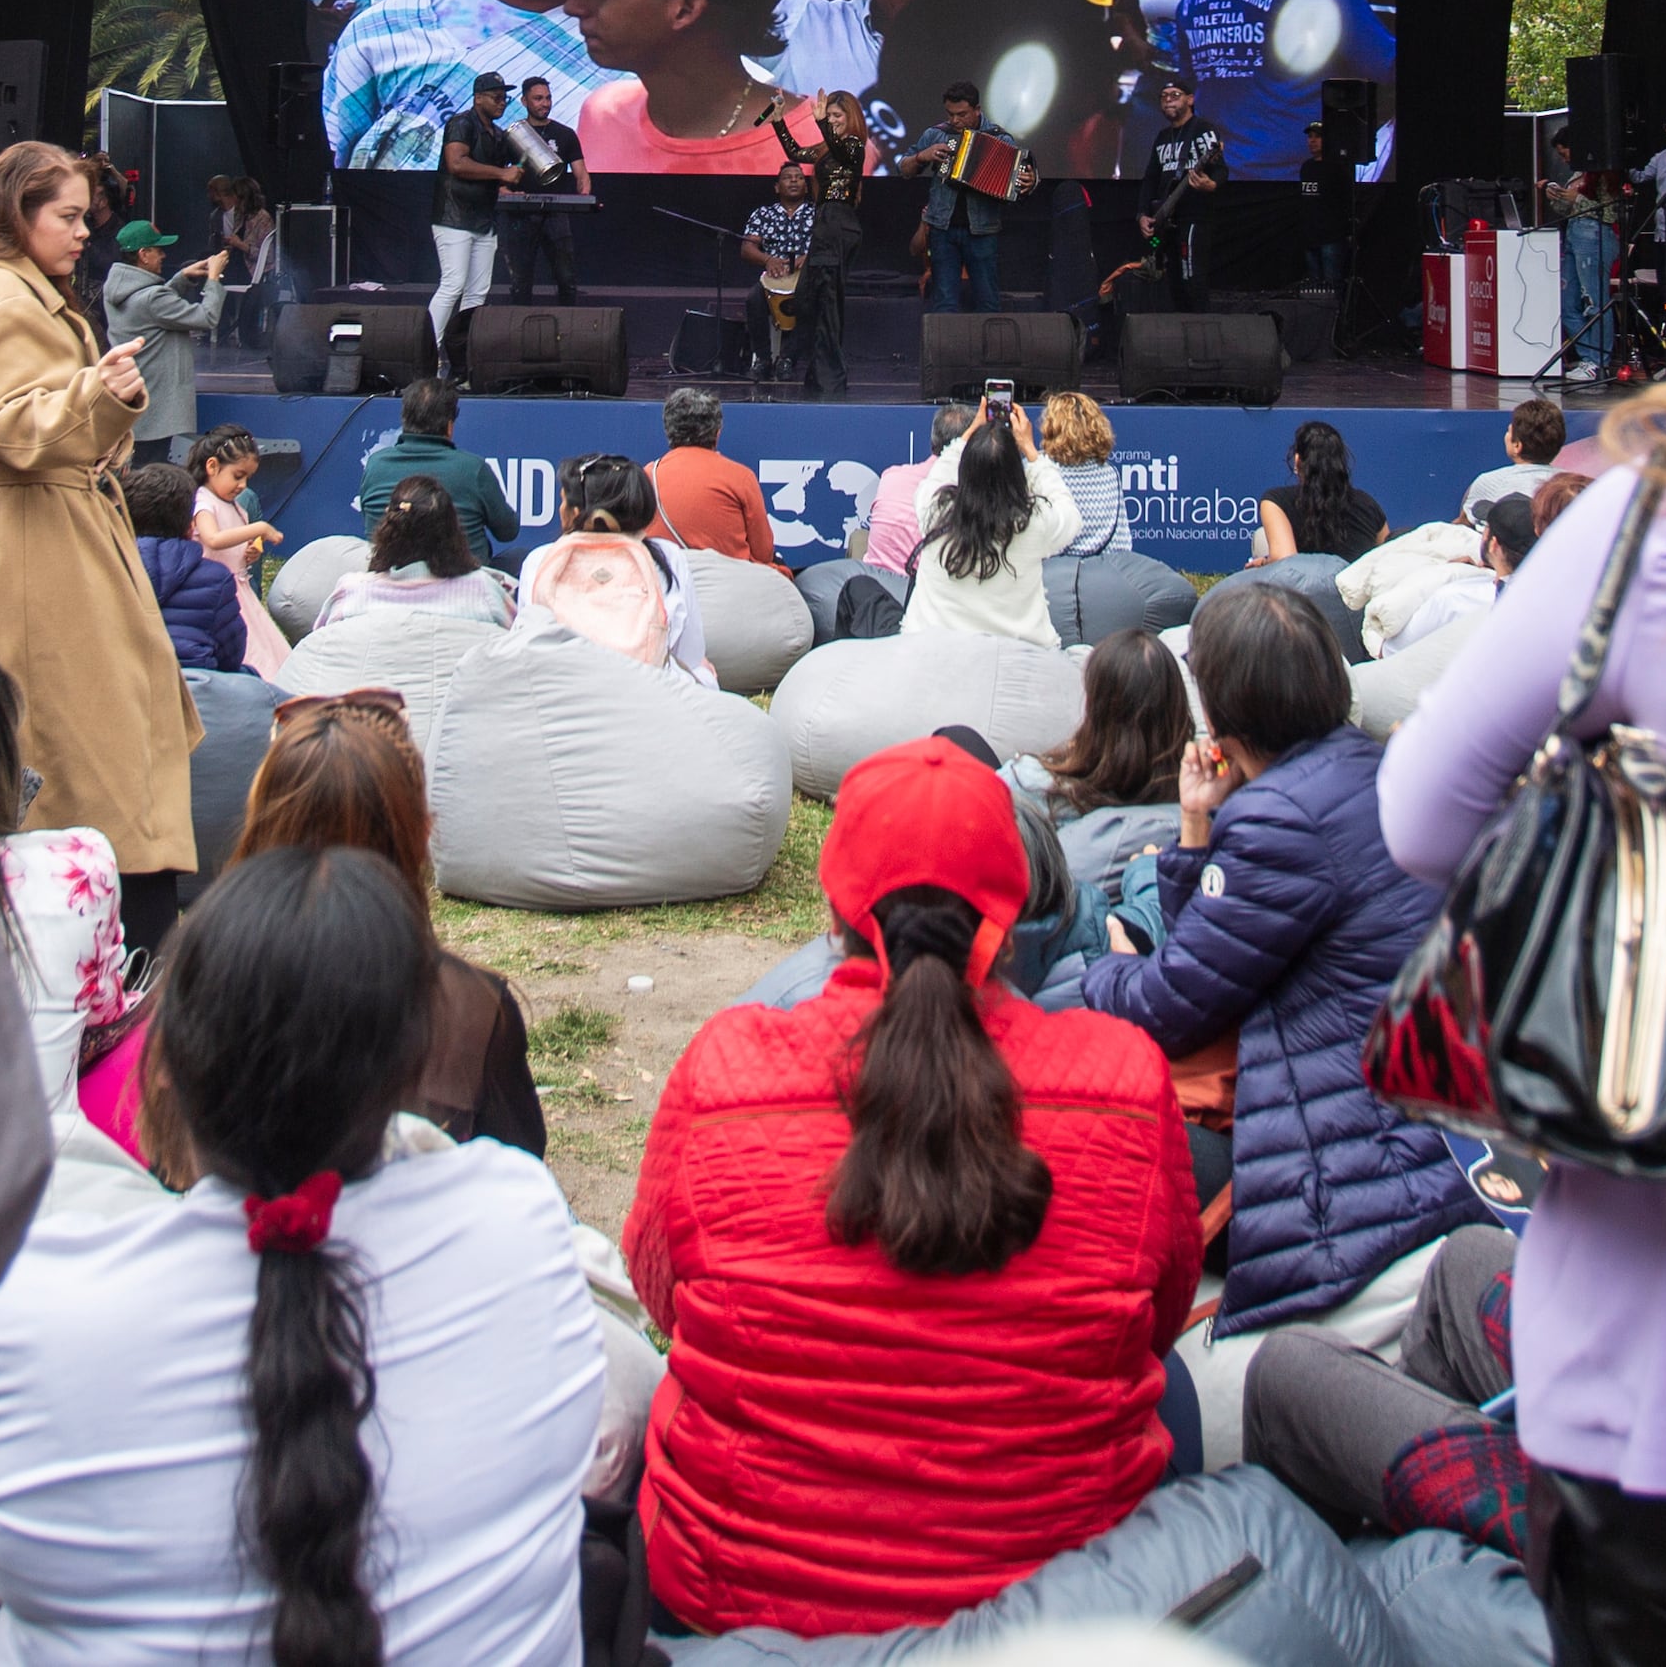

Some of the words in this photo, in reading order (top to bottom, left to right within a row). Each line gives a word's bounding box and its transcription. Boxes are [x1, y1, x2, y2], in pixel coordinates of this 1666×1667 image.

[1108, 450, 1151, 463] ograma
[1121, 454, 1178, 491] nti
[484, 458, 556, 527] ND
[1124, 488, 1259, 524] ontraba
[1166, 527, 1219, 540] Nacional
[1220, 528, 1237, 540] de
